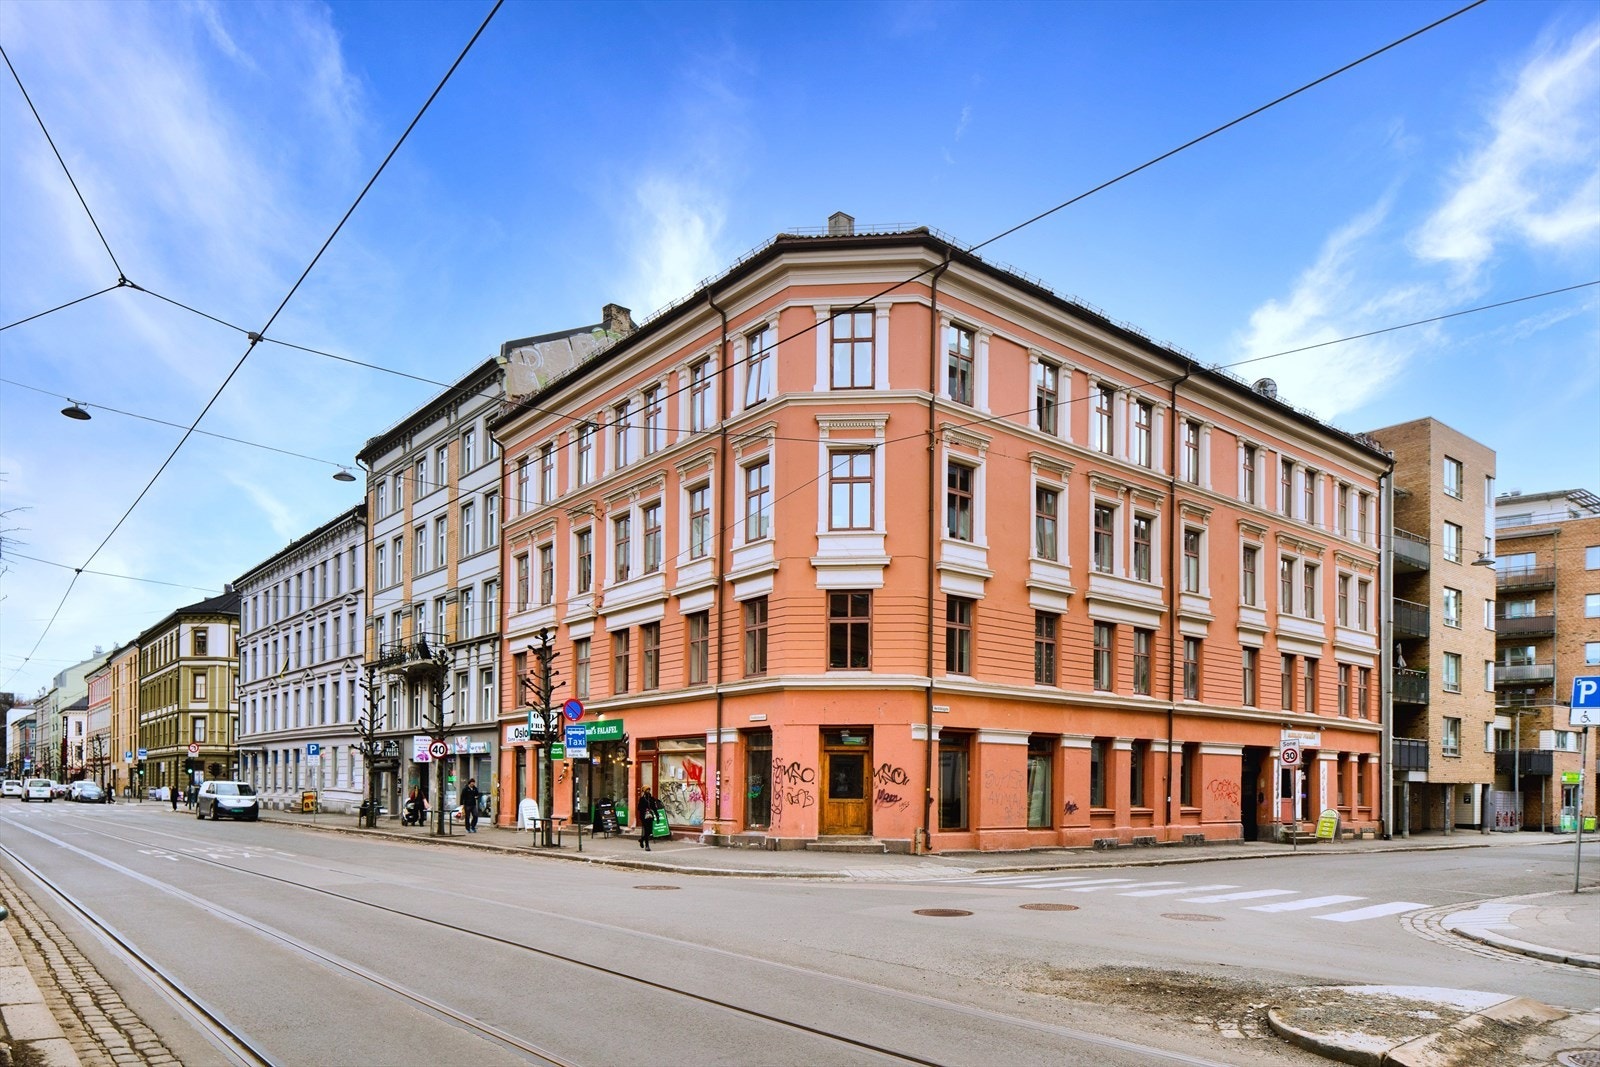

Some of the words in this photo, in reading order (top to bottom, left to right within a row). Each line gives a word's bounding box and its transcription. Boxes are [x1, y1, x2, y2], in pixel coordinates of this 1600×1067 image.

[1579, 680, 1598, 704] P
[514, 727, 528, 738] Oslo
[568, 738, 585, 746] Taxi
[309, 744, 317, 755] P
[432, 745, 445, 755] 40
[1286, 752, 1295, 760] 30
